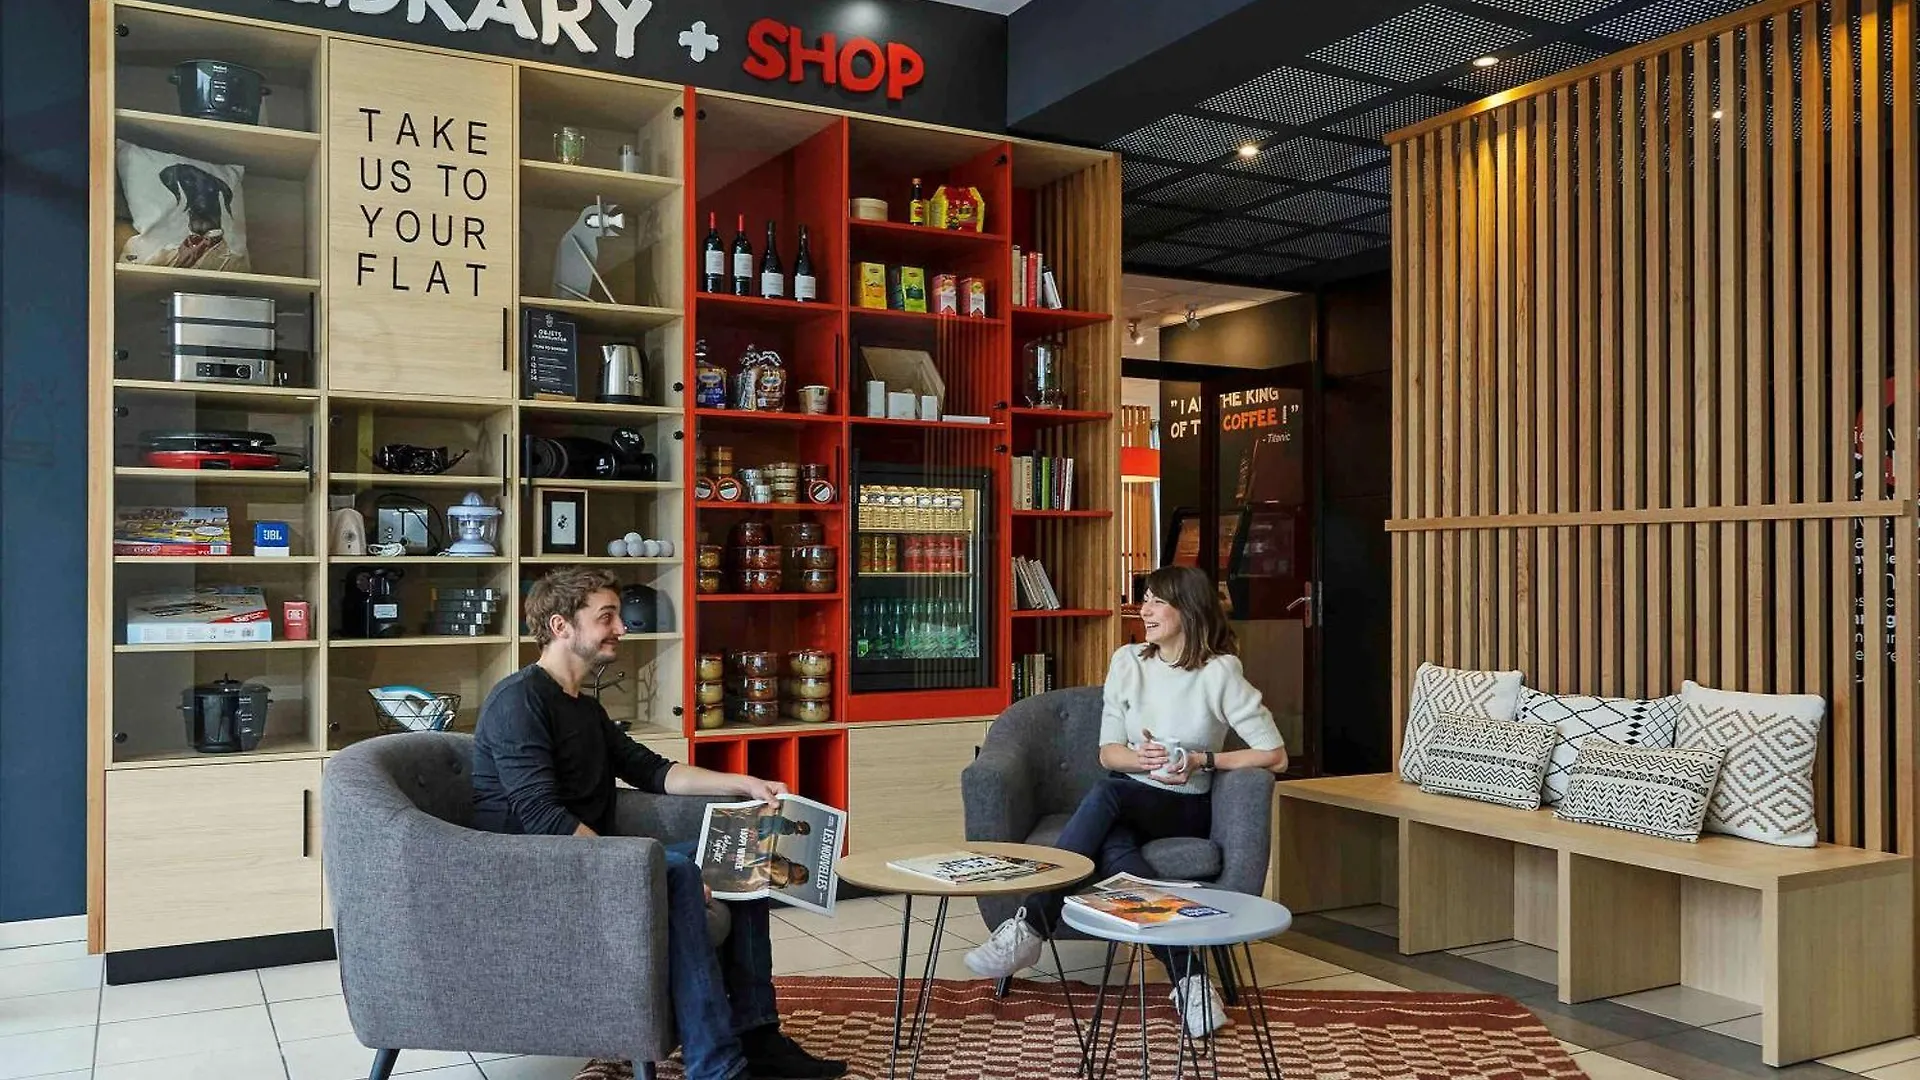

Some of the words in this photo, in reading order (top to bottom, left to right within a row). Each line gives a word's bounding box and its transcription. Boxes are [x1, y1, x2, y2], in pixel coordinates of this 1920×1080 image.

[742, 18, 925, 99] SHOP
[359, 107, 487, 155] TAKE
[360, 156, 411, 193] US
[437, 164, 487, 200] TO
[360, 204, 487, 250] YOUR
[357, 252, 487, 296] FLAT
[1170, 421, 1188, 438] OF
[1223, 407, 1278, 431] COFFEE
[1188, 396, 1201, 414] A
[1246, 387, 1279, 405] KING
[263, 529, 282, 541] JBL
[822, 828, 835, 846] LES
[816, 845, 834, 891] NOUVELLES
